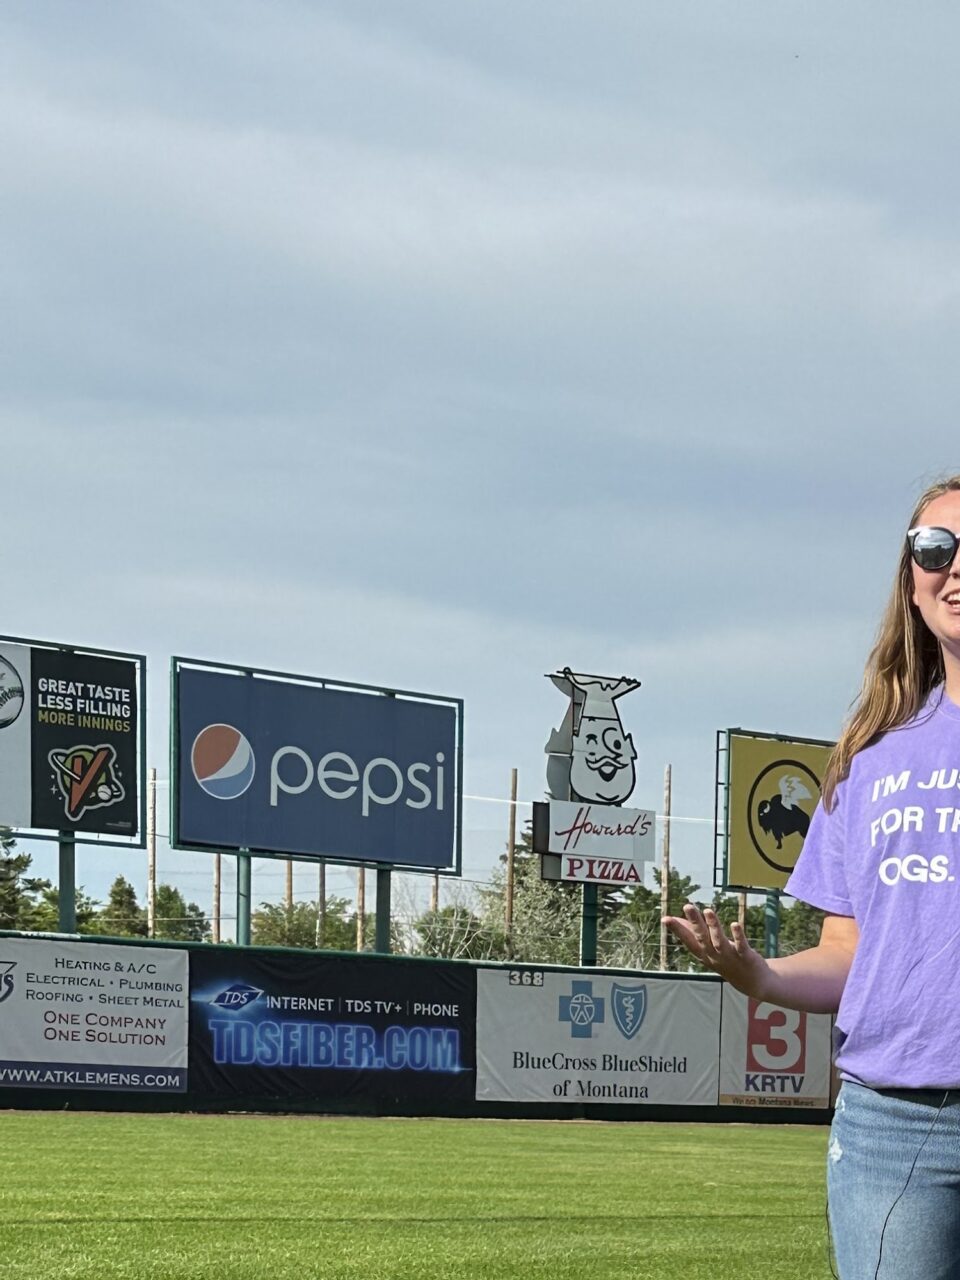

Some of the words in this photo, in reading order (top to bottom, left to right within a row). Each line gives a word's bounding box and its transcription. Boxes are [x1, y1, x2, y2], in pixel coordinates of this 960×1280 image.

[38, 678, 84, 697] GREAT
[87, 684, 130, 702] TASTE
[38, 694, 73, 711] LESS
[77, 700, 131, 717] FILLING
[38, 710, 75, 726] MORE
[78, 715, 131, 732] INNINGS
[270, 746, 445, 817] pepsi
[872, 770, 911, 802] I'M
[555, 806, 652, 850] Howard's
[870, 806, 925, 847] FOR
[566, 858, 641, 882] PIZZA
[55, 958, 111, 972] HEATING
[114, 962, 124, 972] &
[127, 963, 157, 974] A/C
[26, 973, 105, 987] ELECTRICAL
[119, 979, 183, 992] PLUMBING
[510, 971, 543, 986] 368
[26, 989, 83, 1003] ROOFING
[98, 994, 139, 1006] SHEET
[143, 997, 184, 1008] METAL
[224, 991, 249, 1005] TDS
[266, 995, 335, 1011] INTERNET
[345, 999, 371, 1013] TDS
[413, 1002, 459, 1017] PHONE
[44, 1011, 80, 1025] ONE
[85, 1013, 166, 1030] COMPANY
[44, 1027, 80, 1042] ONE
[85, 1029, 166, 1046] SOLUTION
[208, 1019, 460, 1071] TDSFIBER.COM
[751, 1001, 801, 1070] 3
[513, 1051, 597, 1071] BlueCross
[602, 1054, 687, 1073] BlueShield
[553, 1080, 571, 1097] of
[576, 1080, 648, 1098] Montana
[744, 1074, 805, 1093] KRTV
